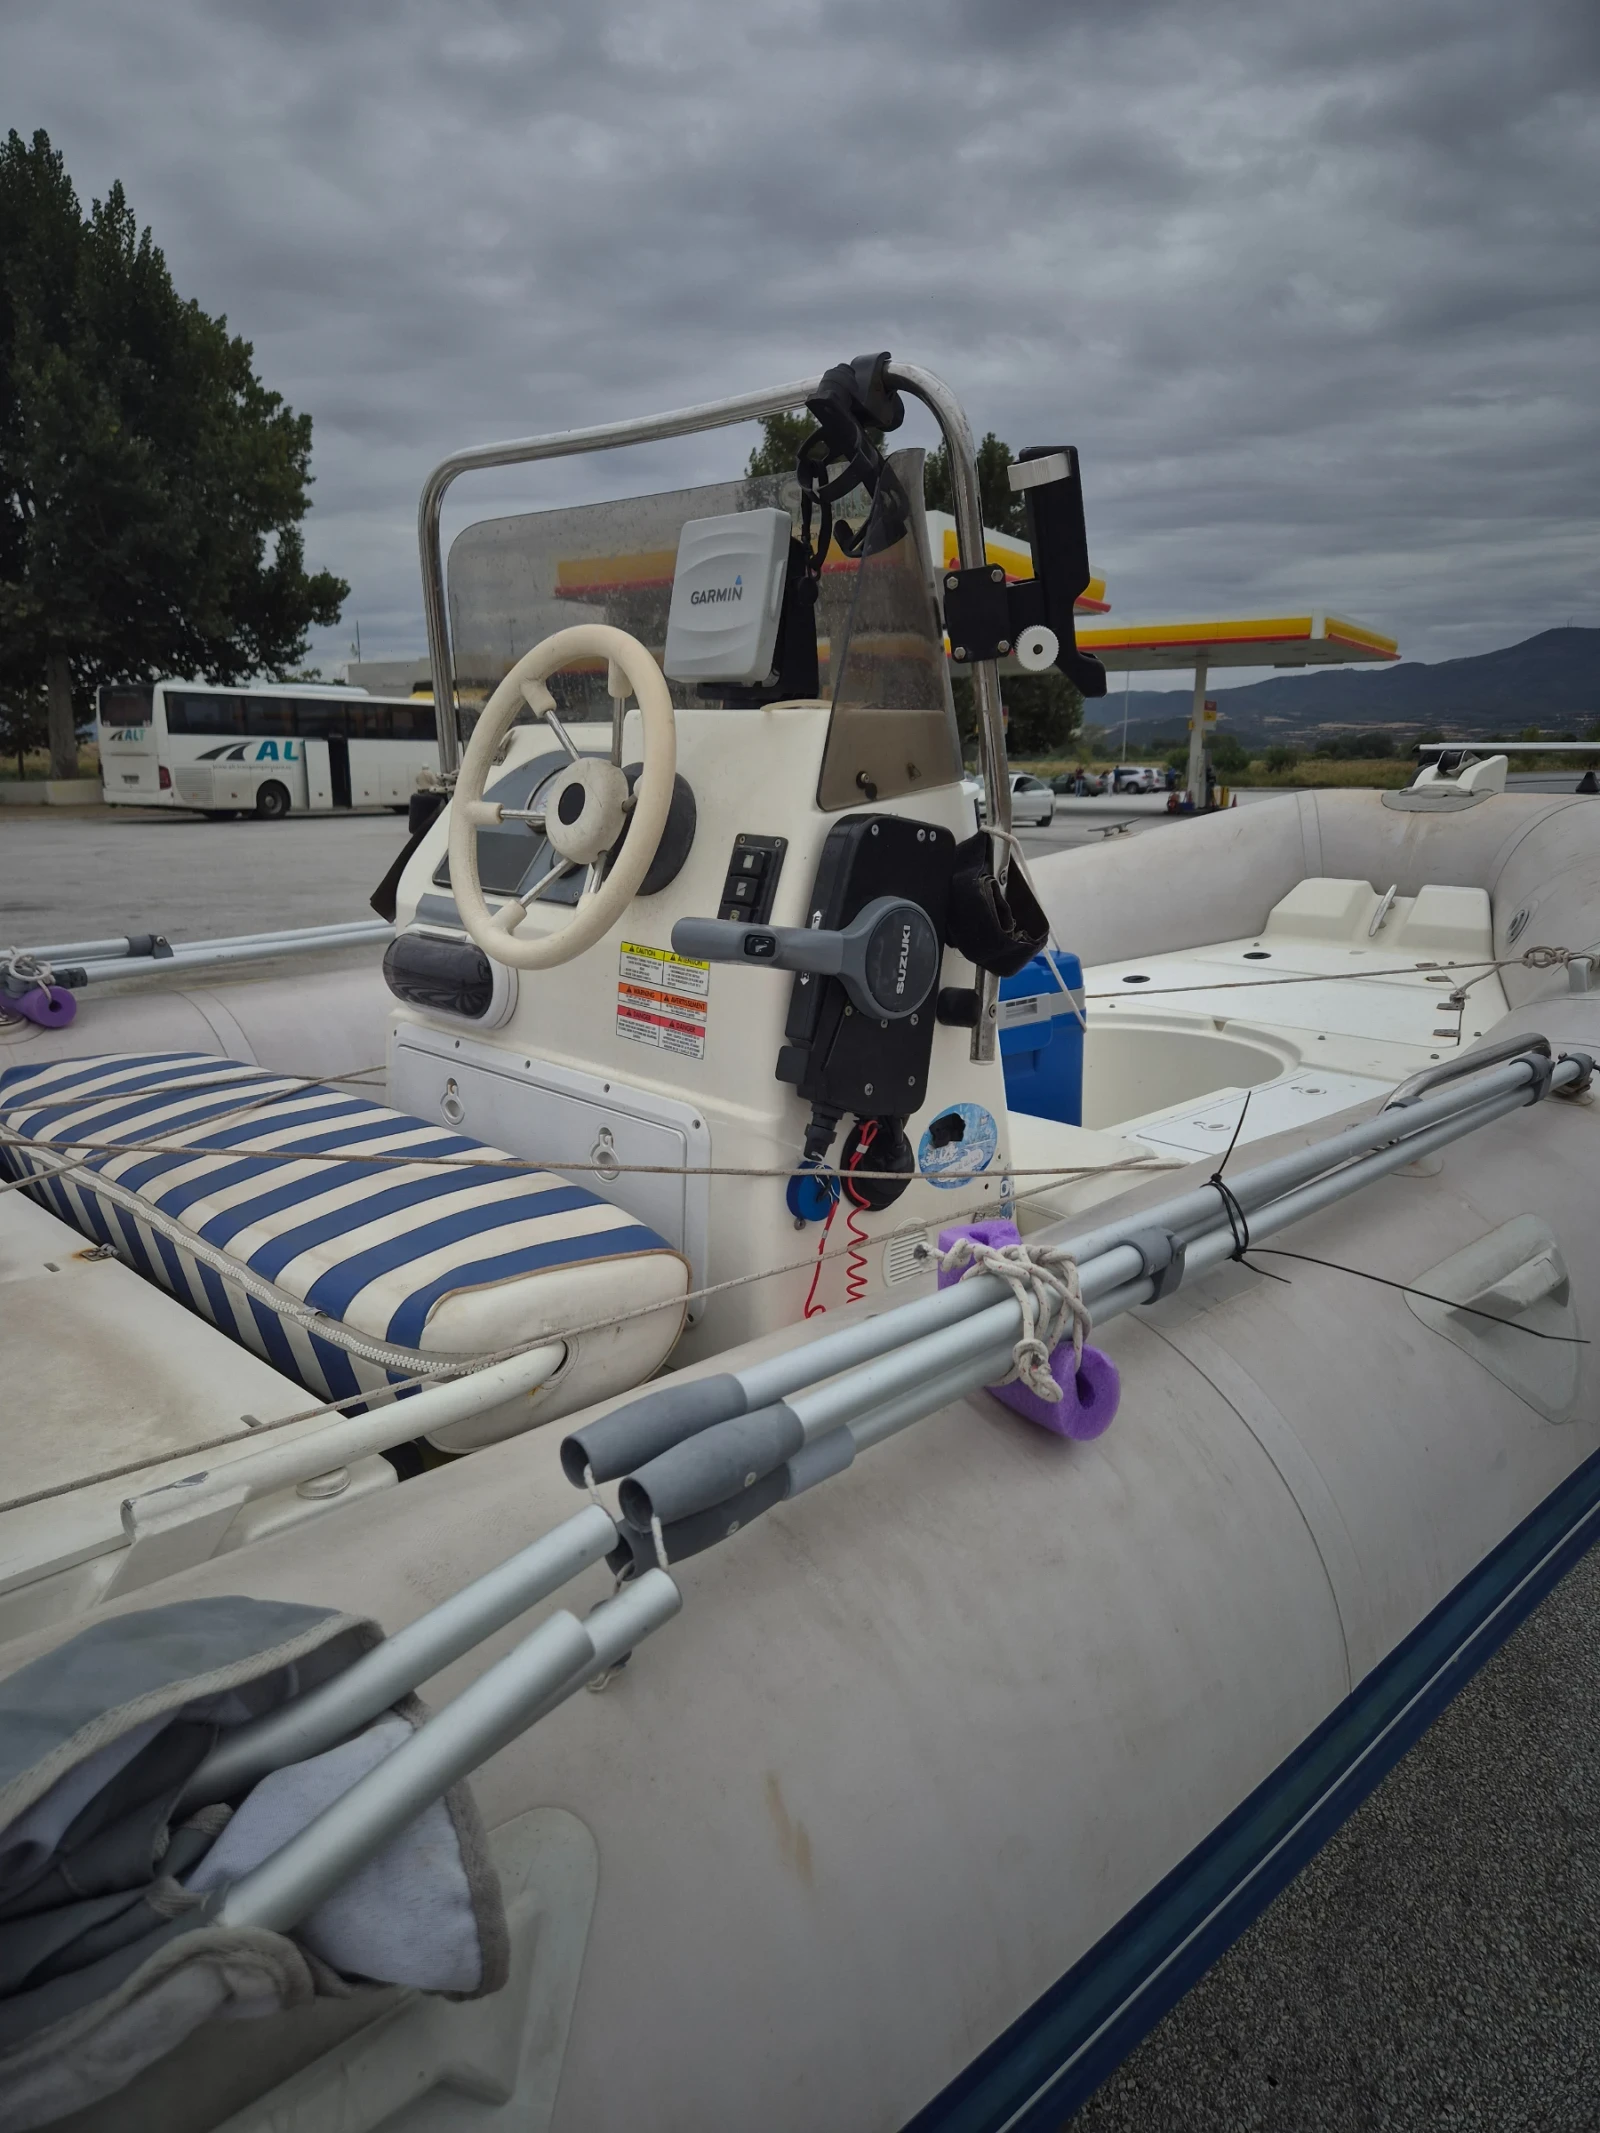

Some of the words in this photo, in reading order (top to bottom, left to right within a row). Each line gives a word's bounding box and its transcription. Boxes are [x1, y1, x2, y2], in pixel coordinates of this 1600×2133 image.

[691, 587, 742, 605] GARMIN
[125, 730, 146, 741] ALT
[255, 740, 305, 761] AL
[636, 947, 656, 957] CAUTION
[896, 925, 911, 995] SUZUKI
[633, 988, 655, 998] WARNING
[671, 996, 705, 1010] AVERTISSEMENT
[633, 1011, 652, 1021] DANGER
[676, 1023, 696, 1033] DANGER
